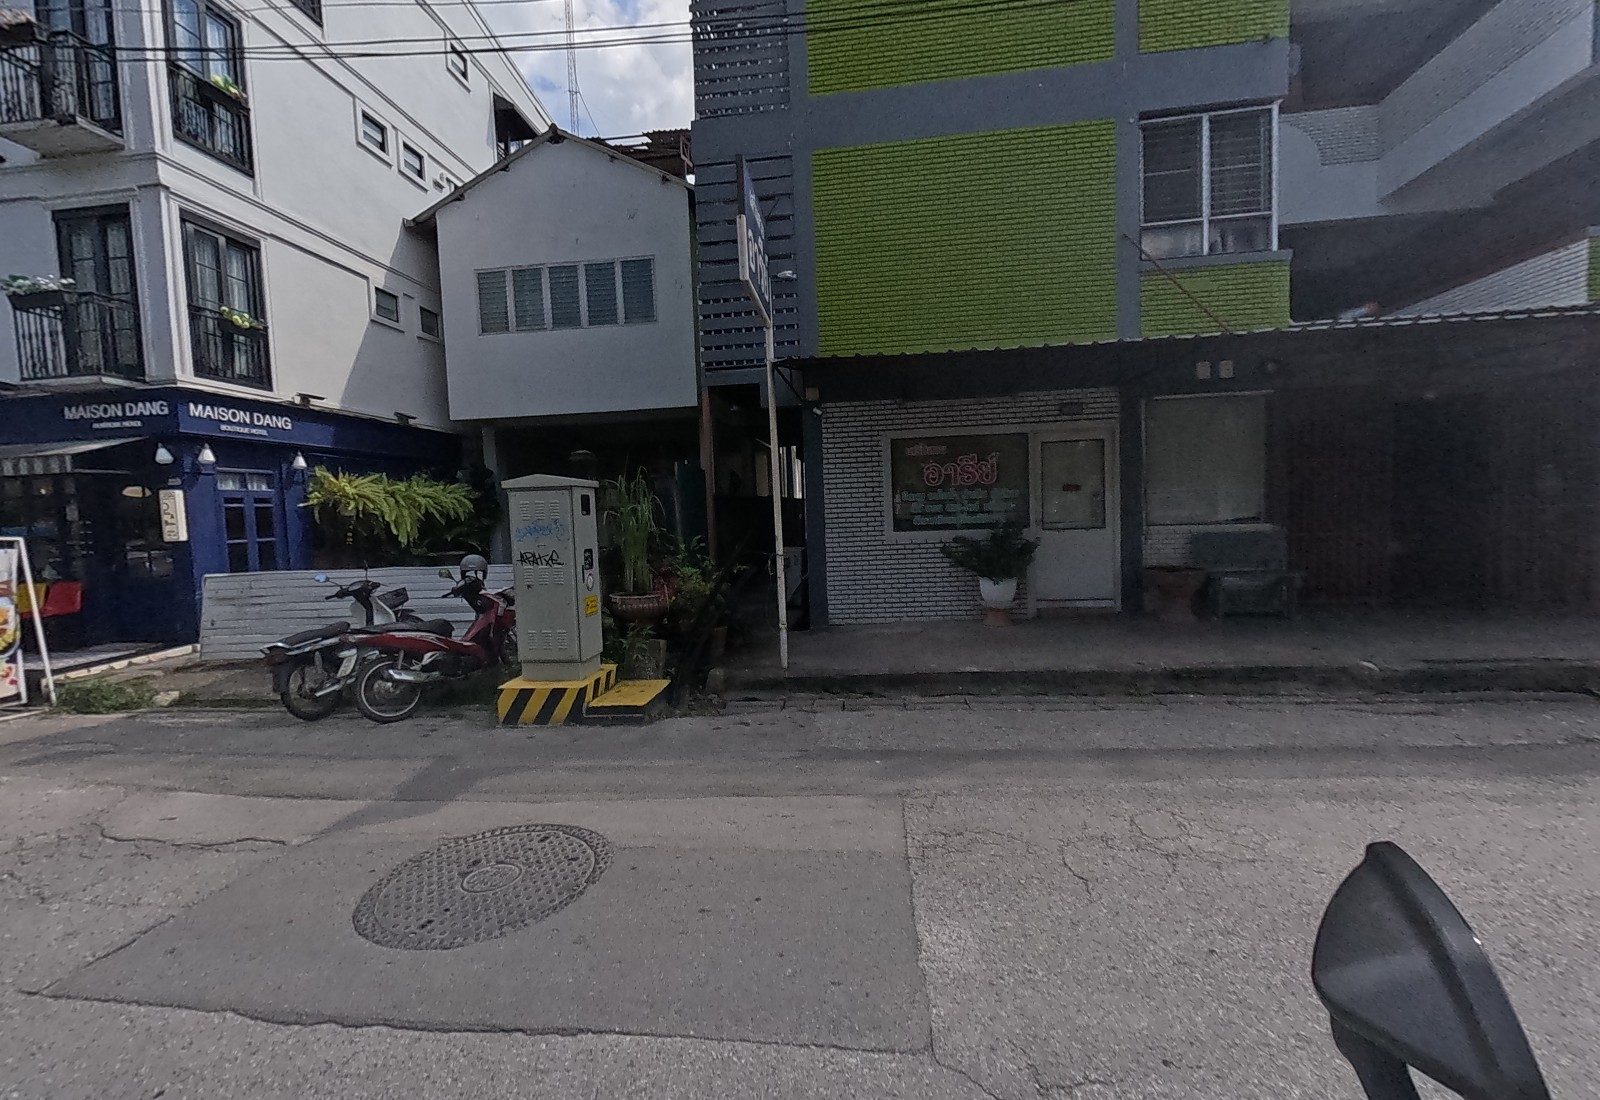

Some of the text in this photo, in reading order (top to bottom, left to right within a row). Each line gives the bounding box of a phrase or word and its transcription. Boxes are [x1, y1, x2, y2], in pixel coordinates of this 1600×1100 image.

[64, 401, 169, 420] MAISON DANG
[189, 402, 292, 430] MAISON DANG
